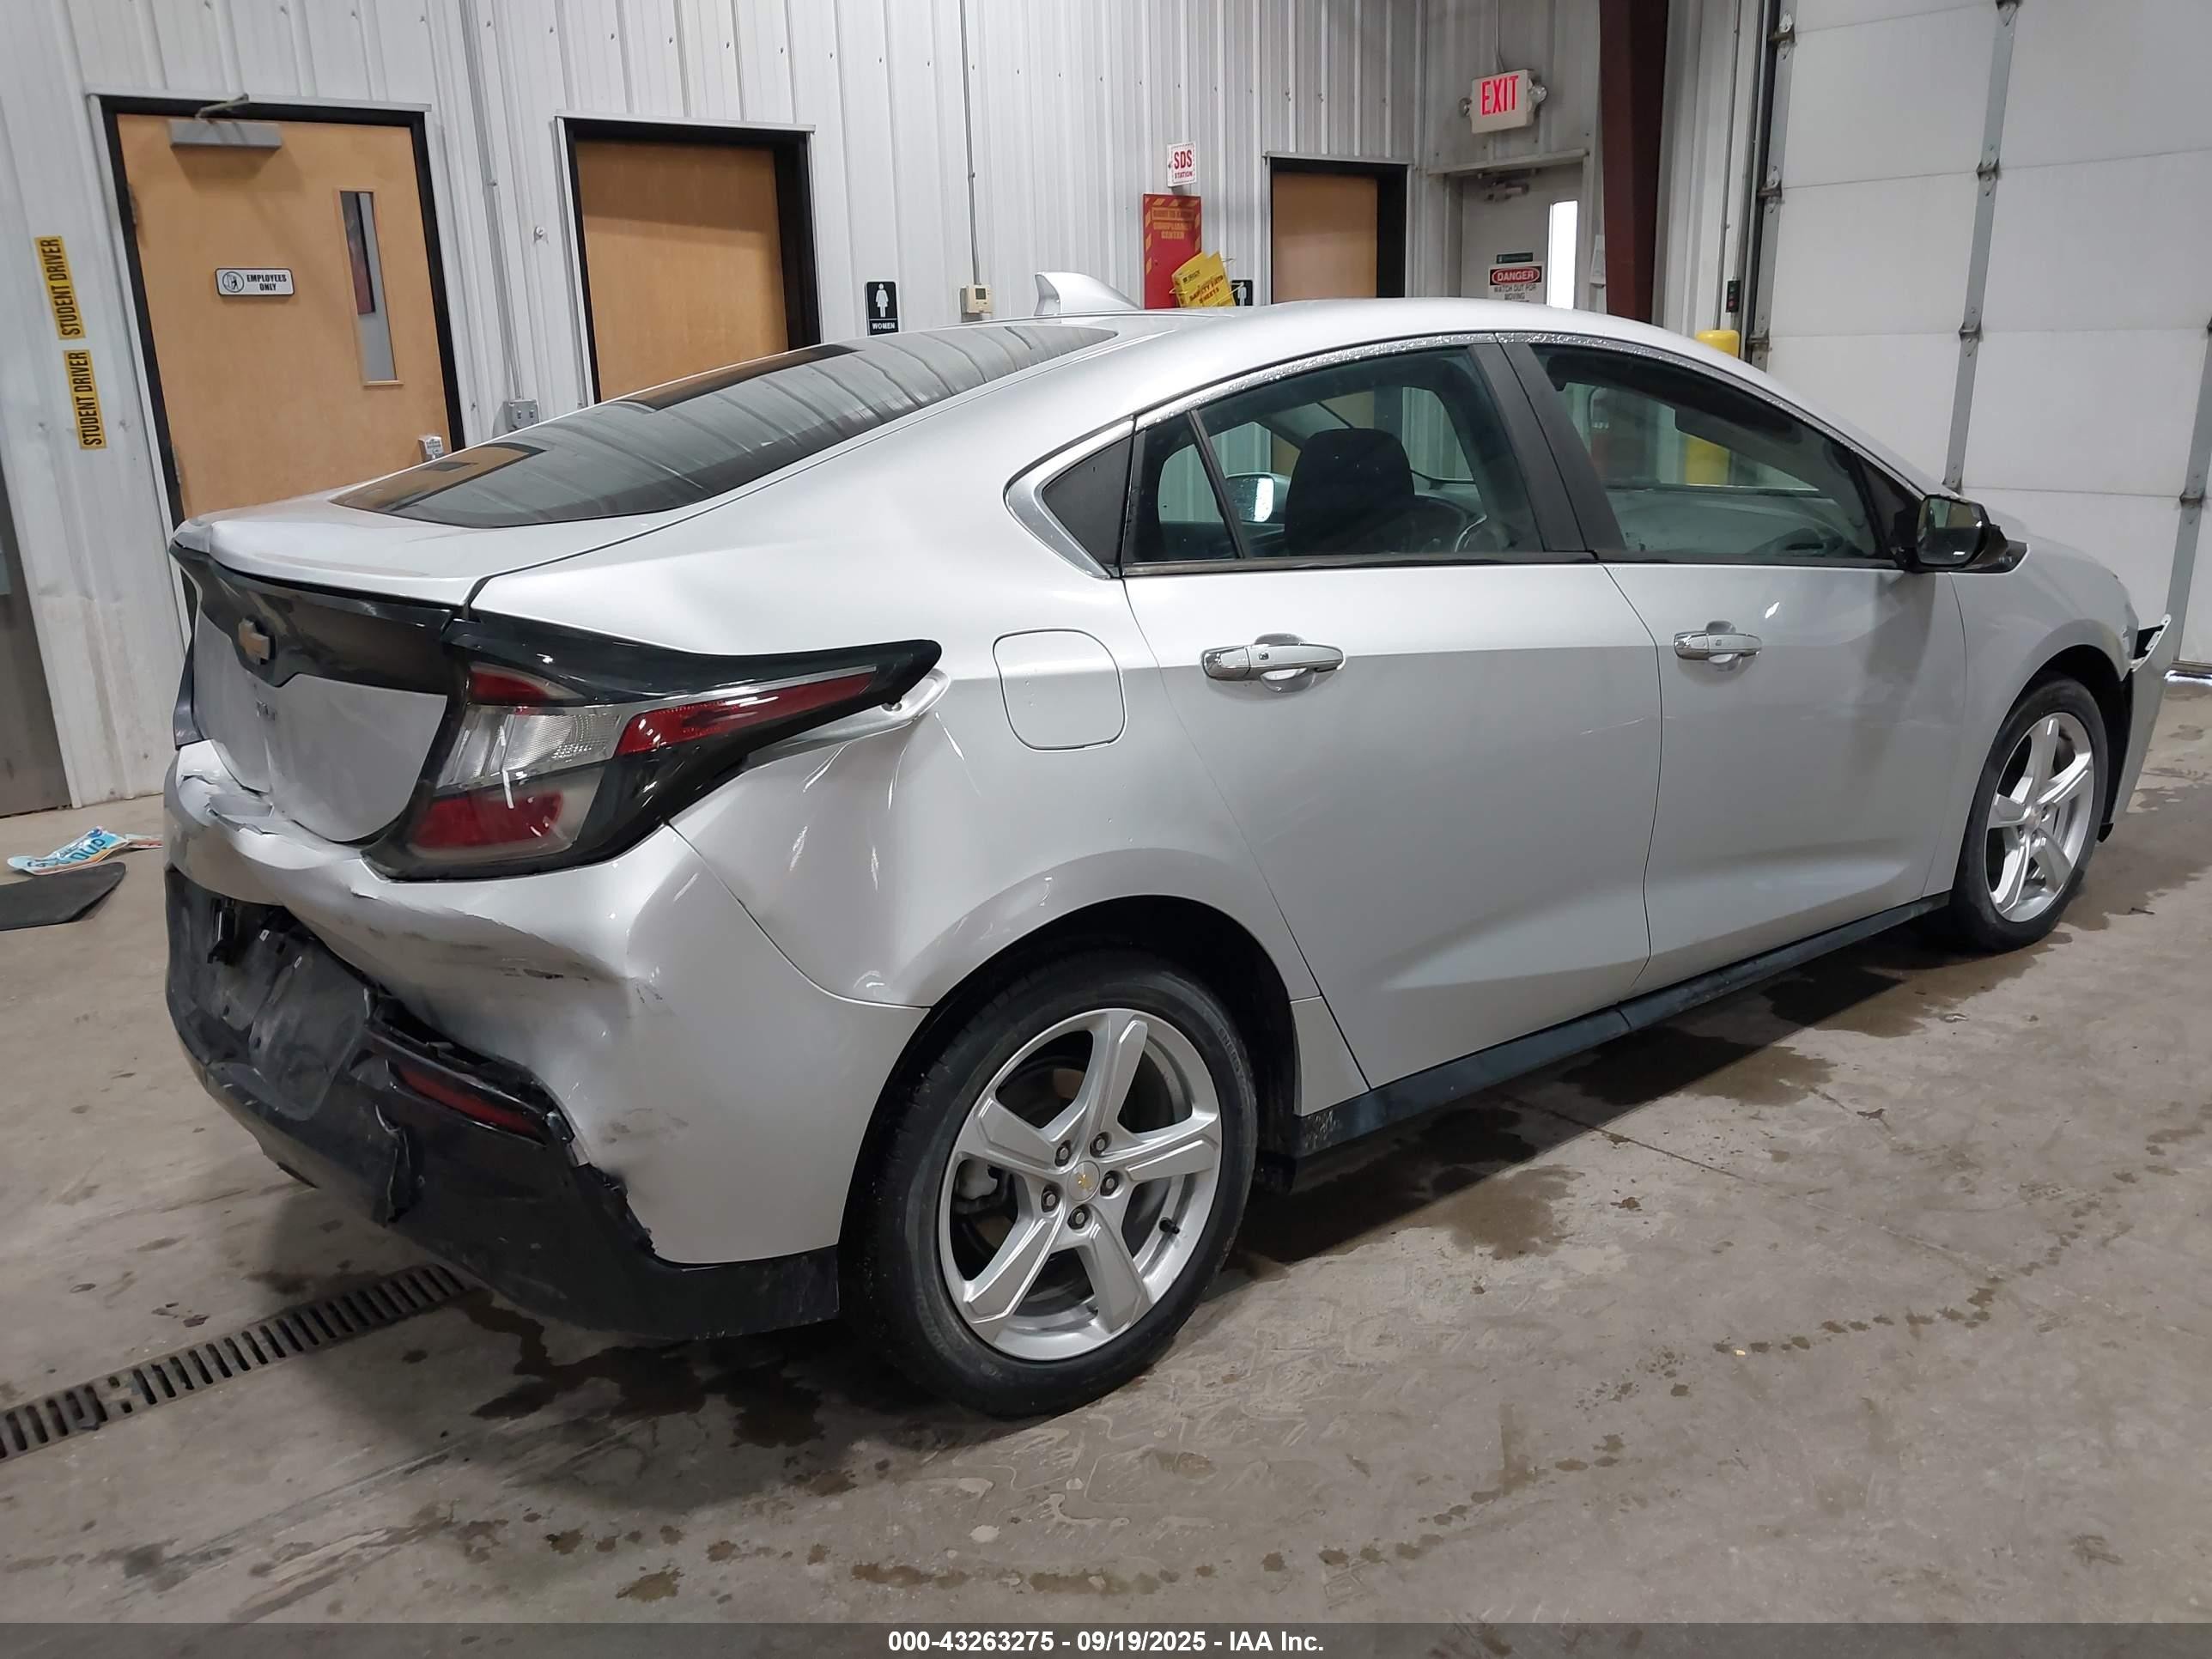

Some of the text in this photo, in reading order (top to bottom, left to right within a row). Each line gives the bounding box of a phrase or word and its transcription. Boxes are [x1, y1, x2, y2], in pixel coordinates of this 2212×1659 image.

[1482, 75, 1519, 115] EXIT
[1174, 149, 1193, 170] SDS
[1174, 171, 1193, 179] STATION
[246, 274, 287, 283] EMPLOYEES
[1497, 270, 1534, 282] DANGER
[40, 239, 82, 336] STUDENT DRIVER
[259, 283, 276, 291] ONLY
[68, 352, 102, 446] STUDENT DRIVER
